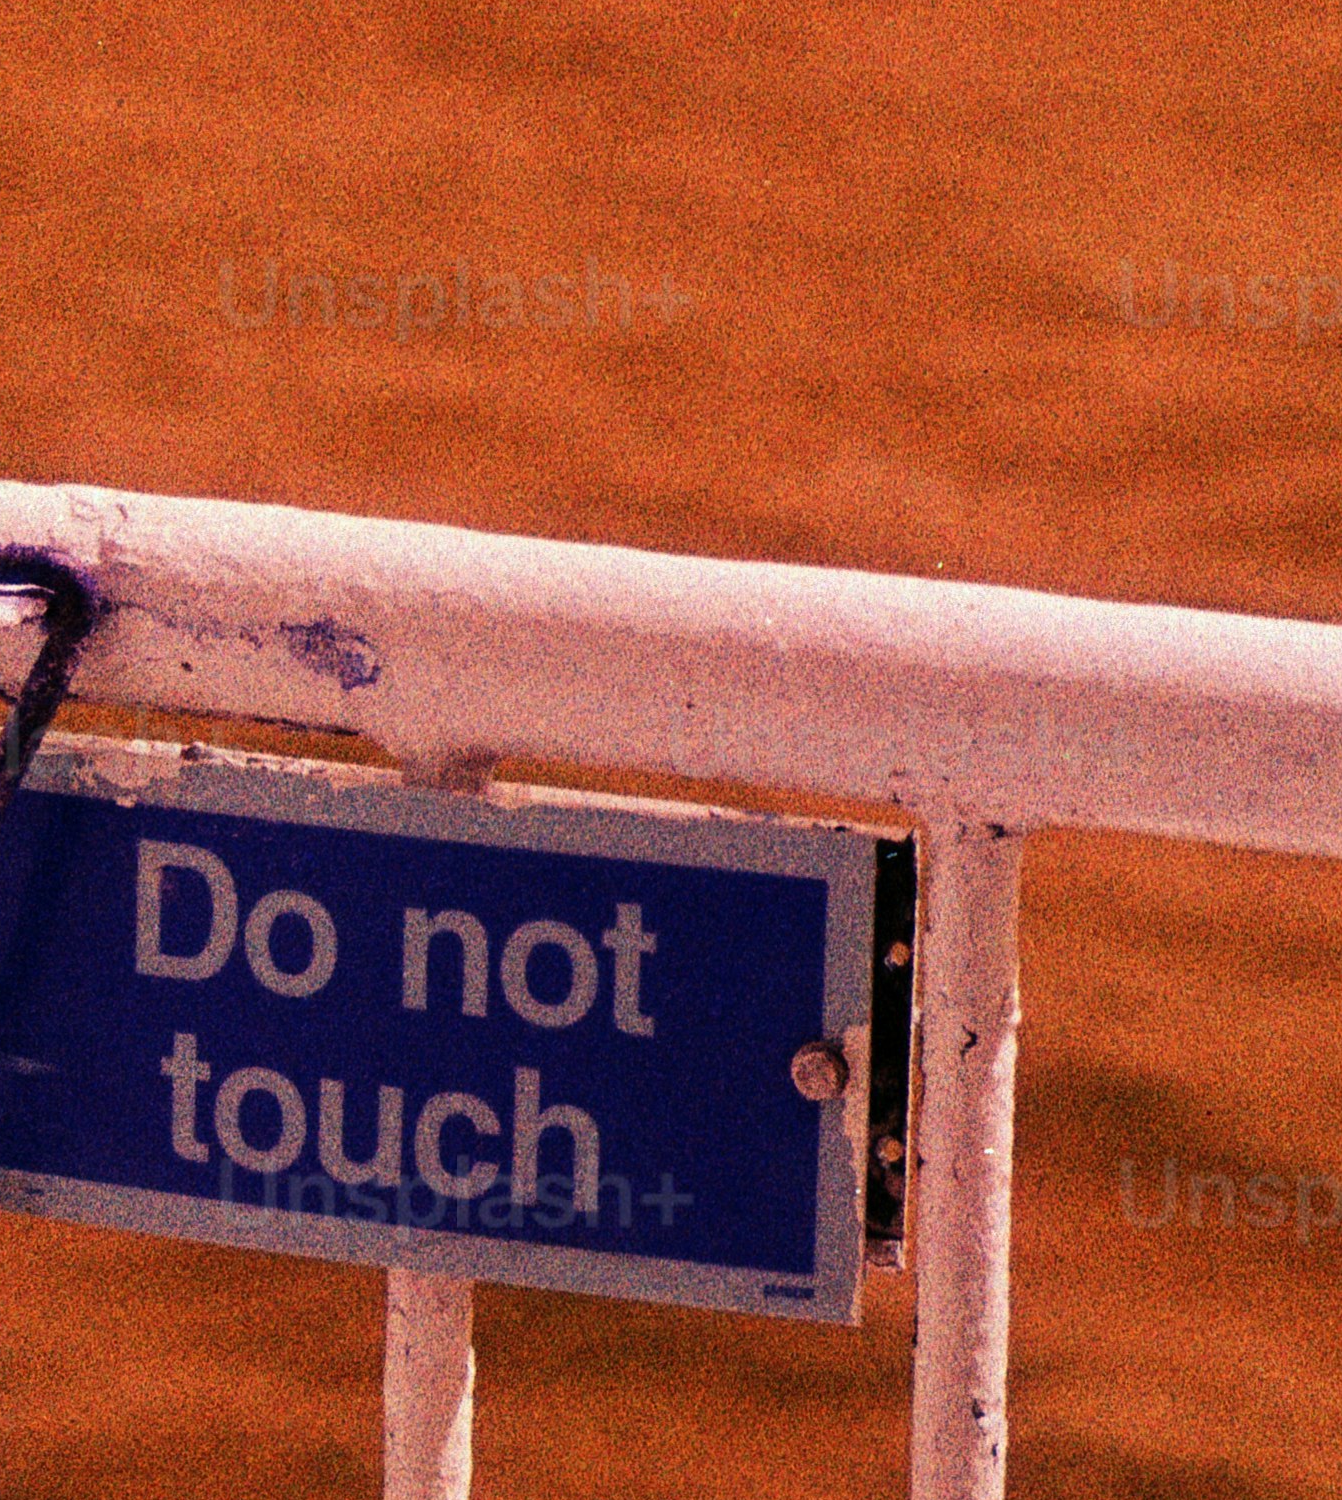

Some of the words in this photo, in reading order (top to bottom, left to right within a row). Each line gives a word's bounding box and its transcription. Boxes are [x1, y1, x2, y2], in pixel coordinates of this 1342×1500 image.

[135, 838, 338, 998] Do
[398, 903, 656, 1038] not
[160, 1032, 600, 1213] touch
